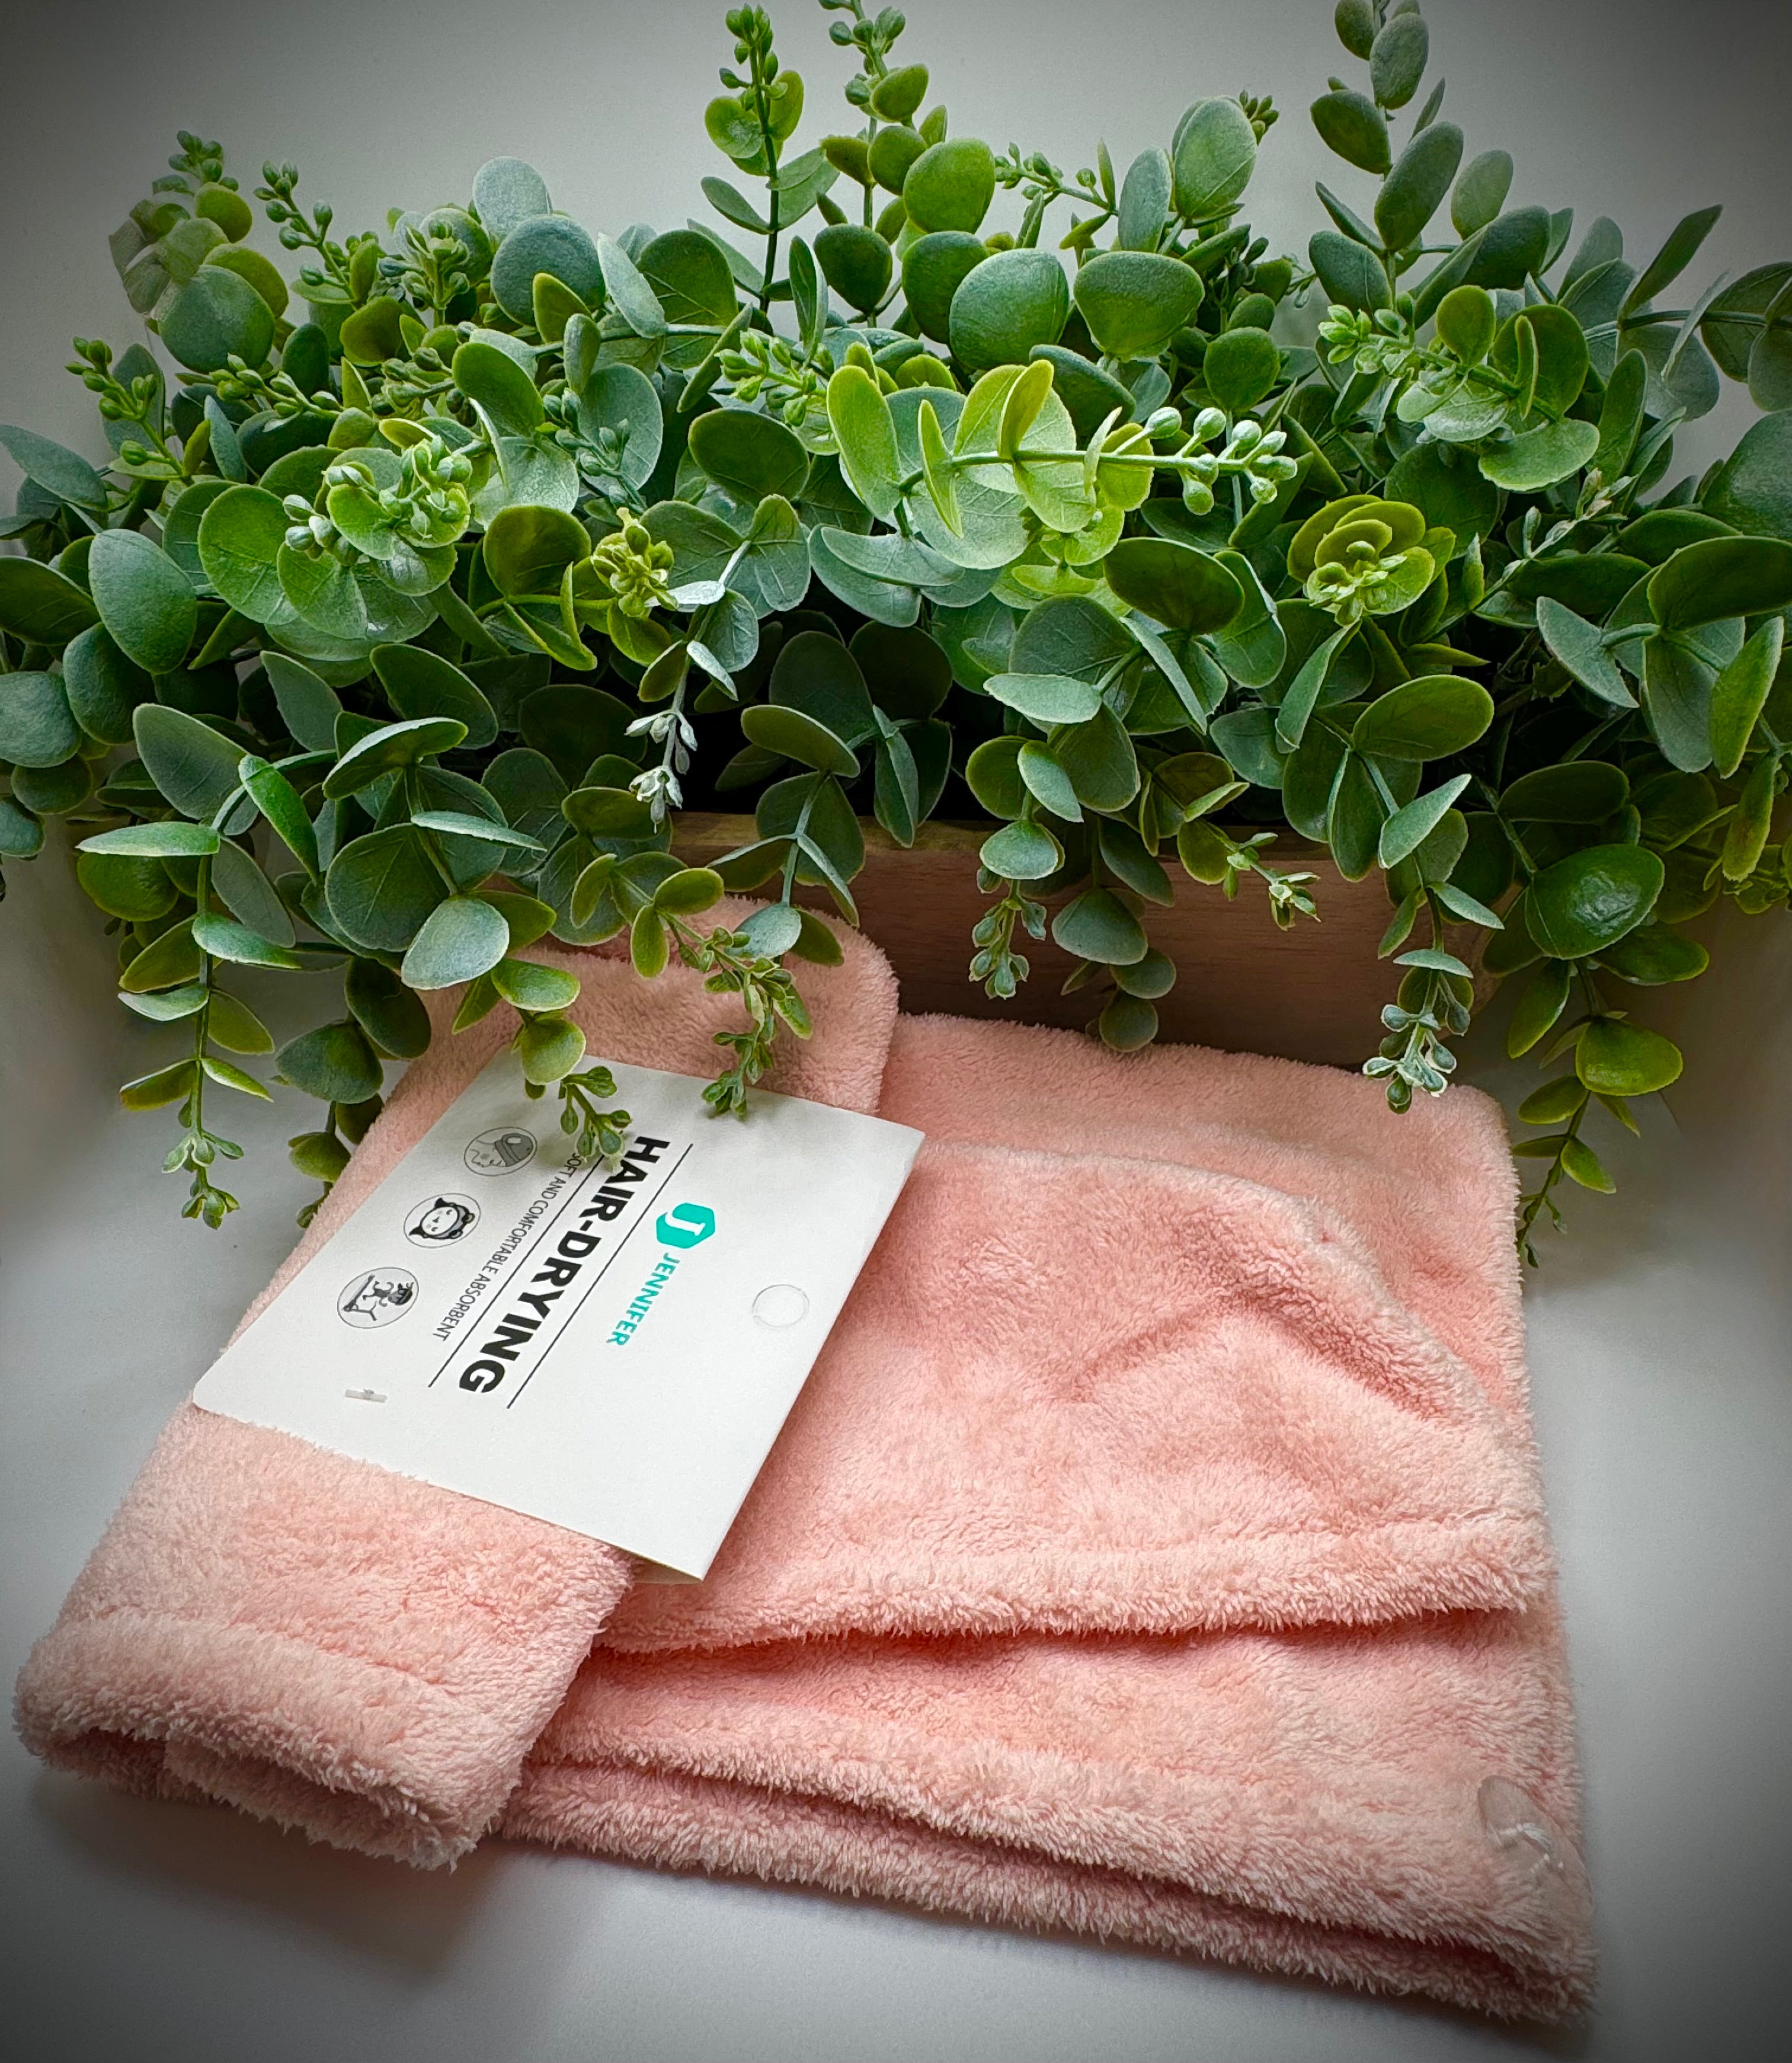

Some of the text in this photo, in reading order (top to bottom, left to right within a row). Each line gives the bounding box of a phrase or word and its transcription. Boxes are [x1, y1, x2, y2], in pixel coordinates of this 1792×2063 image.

[541, 1176, 567, 1200] AND
[459, 1136, 670, 1393] HAIR-DRYING
[481, 1200, 549, 1274] COMFORTABLE
[433, 1273, 491, 1341] ABSORBENT
[606, 1252, 680, 1346] JENNIFER
